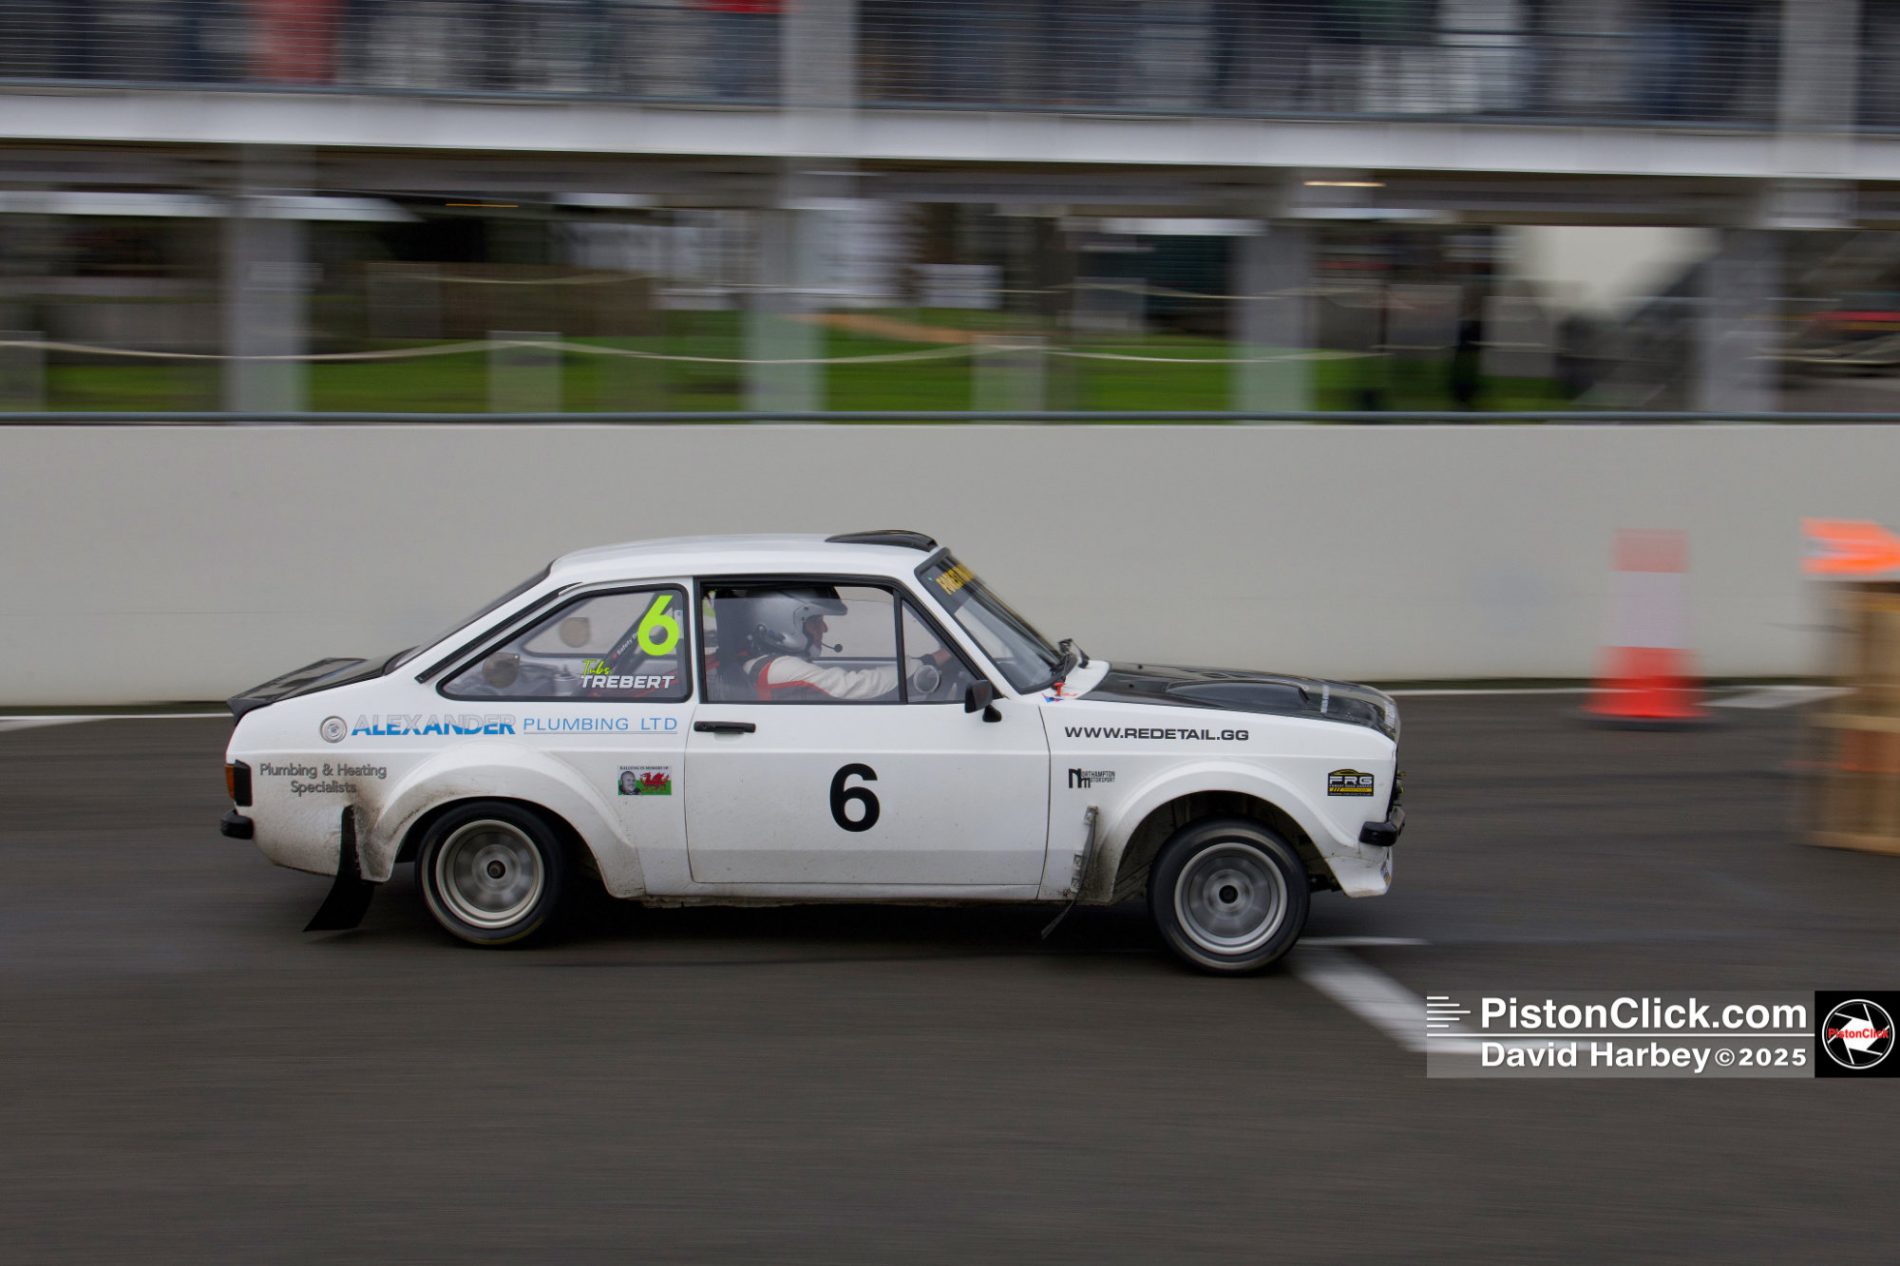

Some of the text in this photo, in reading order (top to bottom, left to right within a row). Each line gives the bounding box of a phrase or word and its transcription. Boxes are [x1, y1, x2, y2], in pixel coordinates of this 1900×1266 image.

[637, 594, 680, 656] 6
[581, 658, 611, 677] Tubs
[581, 675, 675, 689] TREBERT
[351, 714, 678, 736] ALEXANDER PLUMBING LTD
[1065, 726, 1249, 741] WWW.REDETAIL.GG
[260, 762, 387, 779] Plumbing & Heating
[290, 780, 357, 797] Specialists
[829, 763, 880, 832] 6
